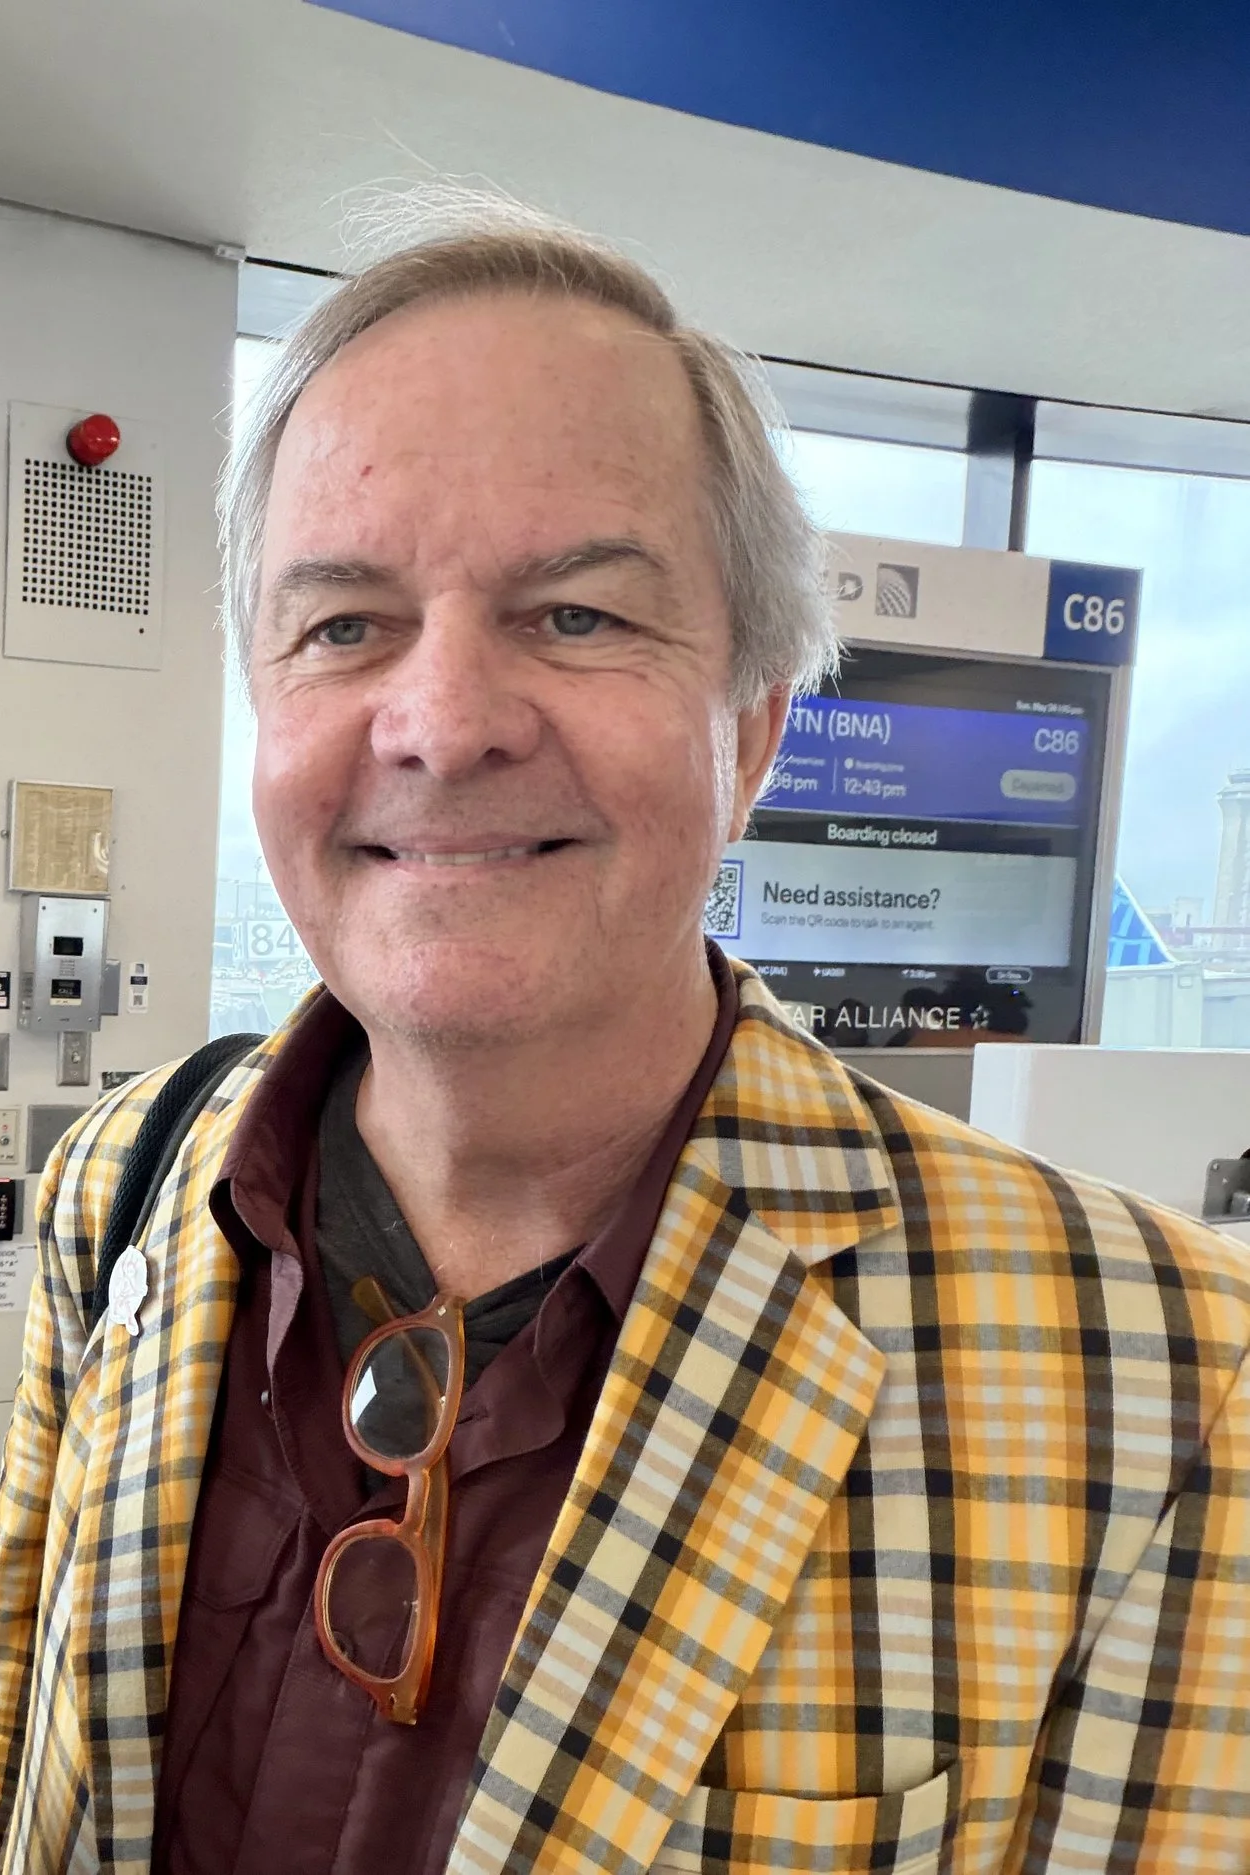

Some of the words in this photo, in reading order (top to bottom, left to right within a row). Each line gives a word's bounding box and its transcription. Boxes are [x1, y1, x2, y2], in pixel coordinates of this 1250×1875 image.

[1063, 593, 1126, 635] C86
[793, 707, 823, 735] TN
[828, 710, 891, 745] (BNA)
[1034, 728, 1080, 755] C86
[793, 777, 819, 793] pm
[882, 783, 907, 799] pm
[827, 823, 890, 847] Boarding
[890, 826, 938, 846] closed
[762, 880, 820, 906] Need
[824, 886, 942, 911] assistance?
[761, 911, 787, 926] Scan
[789, 913, 806, 927] the
[807, 914, 823, 928] QR
[824, 916, 849, 929] code
[251, 923, 300, 956] 84
[835, 1005, 961, 1030] ALLIANCE
